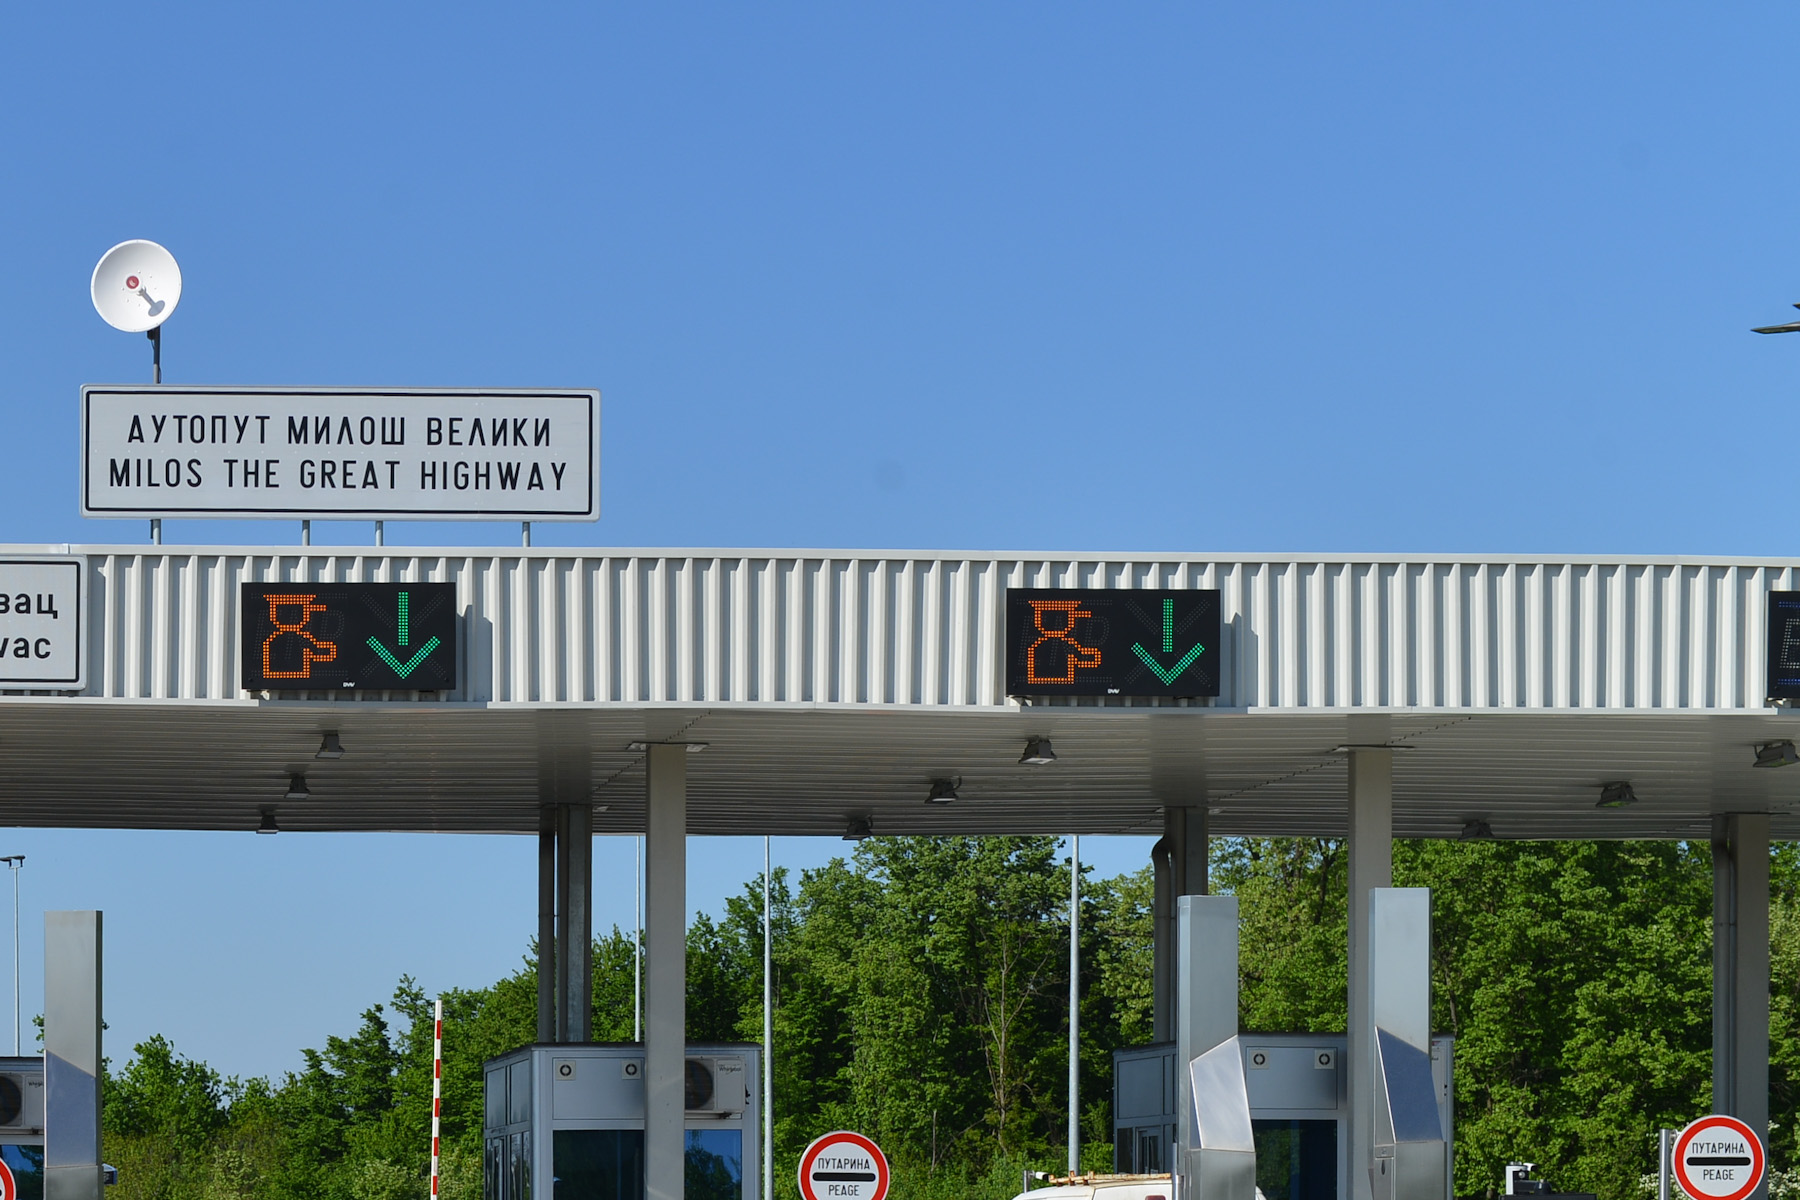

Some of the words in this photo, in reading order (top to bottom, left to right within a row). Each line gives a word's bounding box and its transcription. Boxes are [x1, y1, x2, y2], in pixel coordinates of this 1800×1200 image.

[127, 414, 271, 444] АУТОПУТ
[287, 415, 405, 446] МИЛОШ
[426, 417, 550, 447] ВЕЛИКИ
[109, 458, 203, 488] MILOS
[223, 459, 280, 488] THE
[299, 459, 401, 489] GREAT
[420, 460, 567, 491] HIGHWAY
[1692, 1142, 1745, 1154] ПУТАРИНА
[817, 1157, 871, 1170] ПУТАРИНА
[1703, 1169, 1735, 1181] PEAGE
[828, 1184, 860, 1196] PEAGE
